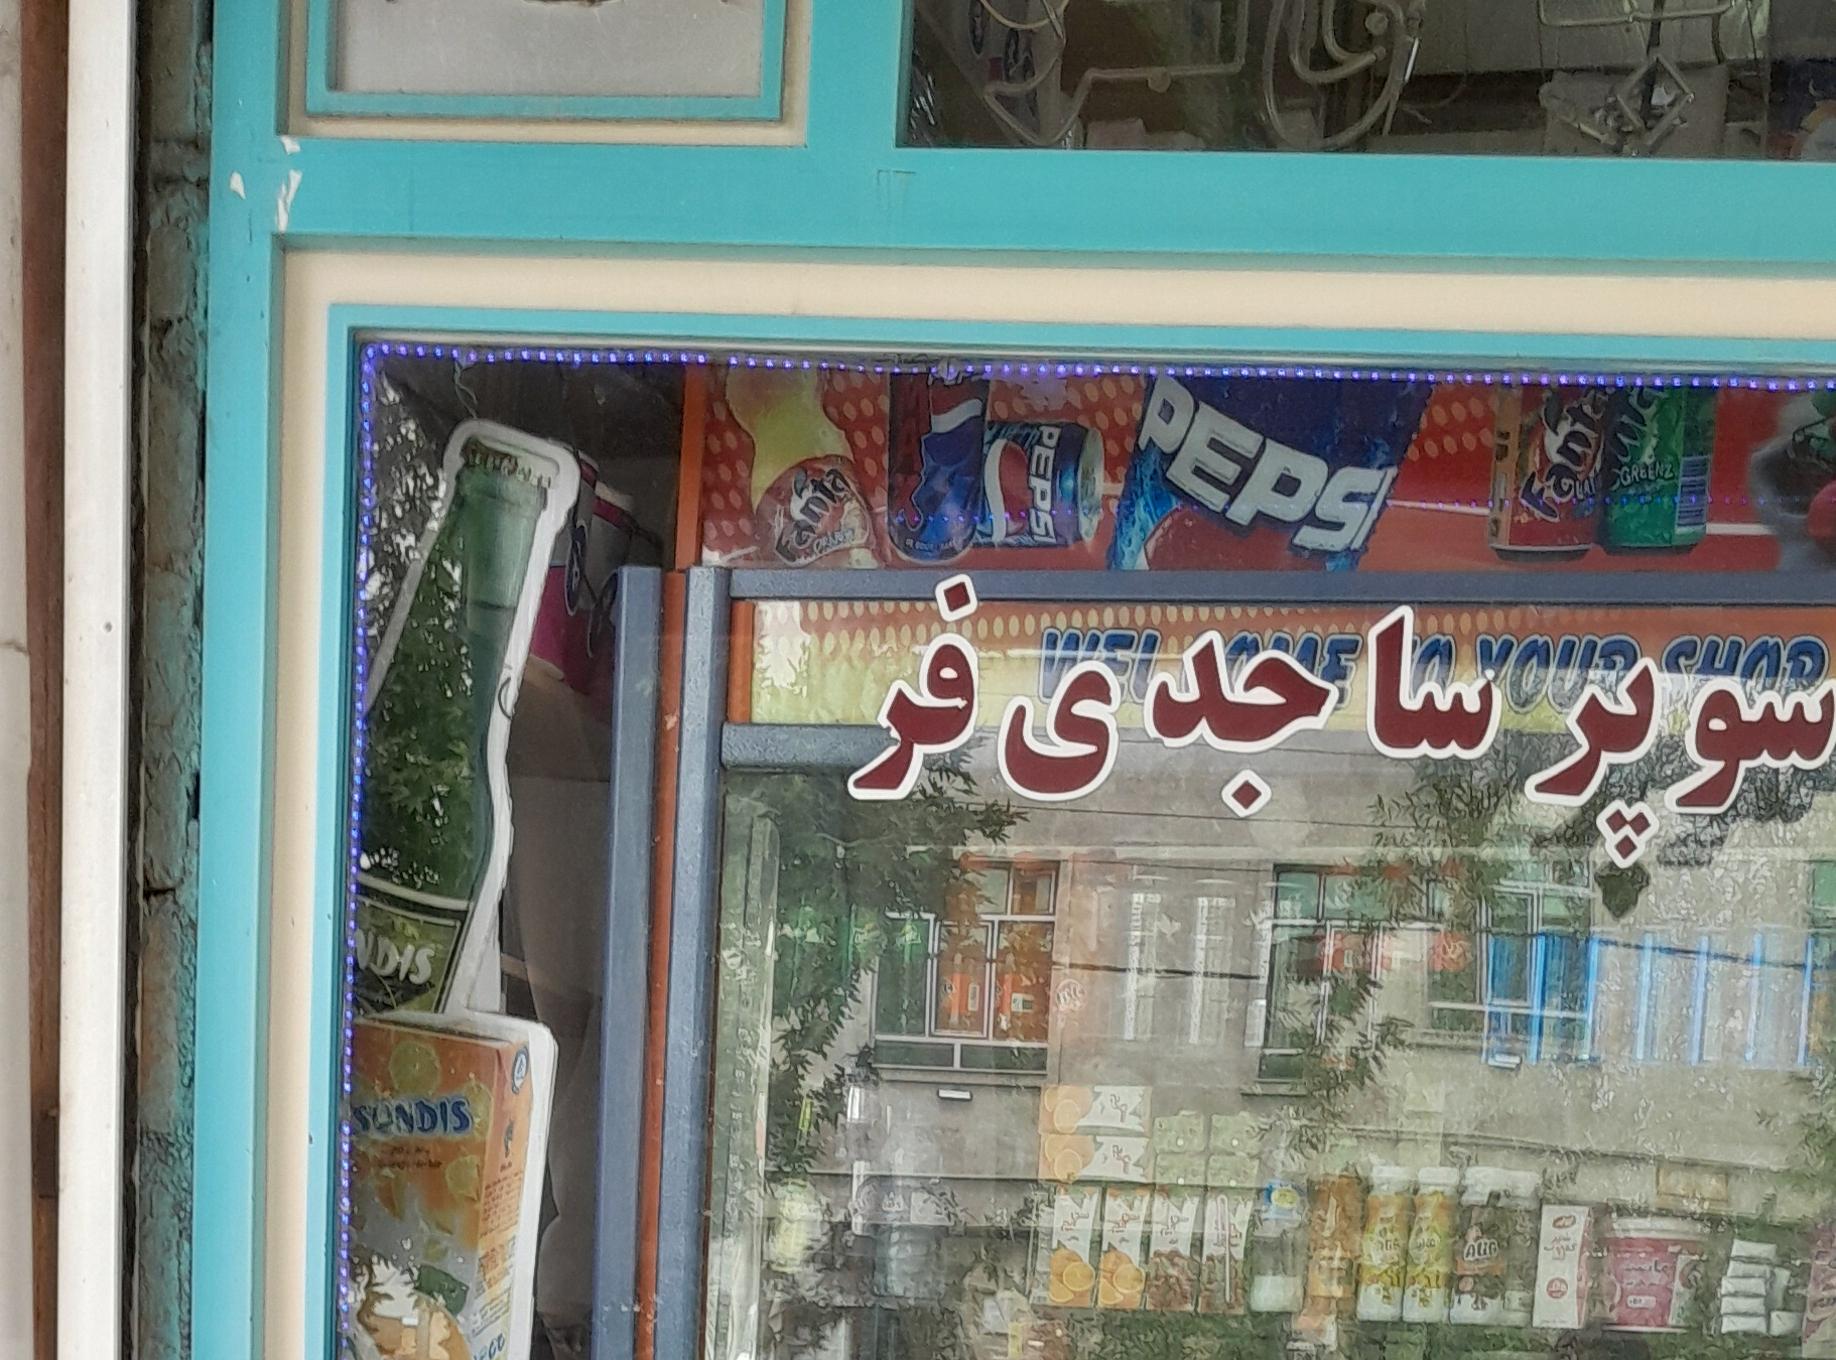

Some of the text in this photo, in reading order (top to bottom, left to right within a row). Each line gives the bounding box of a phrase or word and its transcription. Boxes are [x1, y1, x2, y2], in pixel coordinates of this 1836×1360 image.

[775, 466, 851, 566] Fanta
[1030, 425, 1060, 544] PEPSI
[1138, 374, 1399, 552] PEPSI
[848, 574, 979, 800] فر
[1661, 634, 1830, 712] SHOP
[1525, 655, 1836, 868] سوپر
[352, 1099, 472, 1136] SUNDIS
